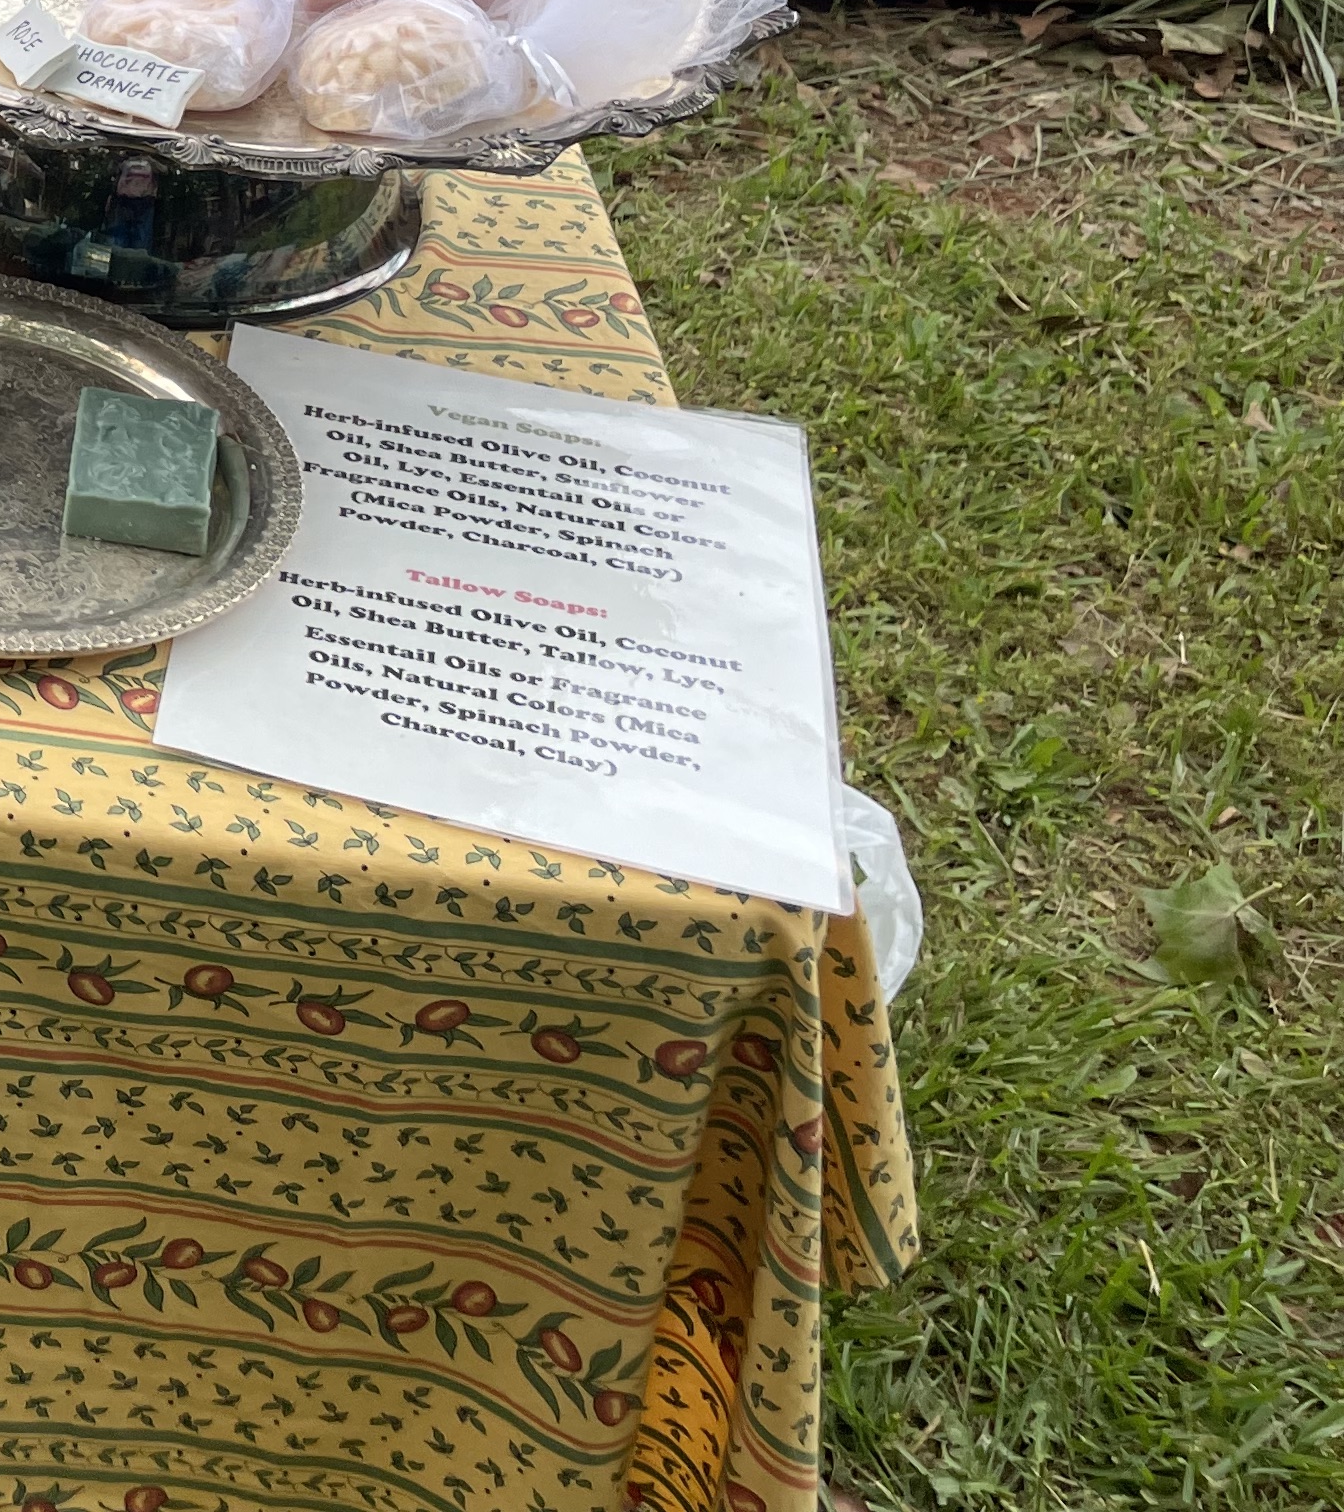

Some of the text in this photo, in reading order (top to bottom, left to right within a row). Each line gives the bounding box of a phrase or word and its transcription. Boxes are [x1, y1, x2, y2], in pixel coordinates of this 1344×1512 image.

[6, 20, 43, 52] ROSE
[74, 44, 189, 83] HOCOLATE
[77, 71, 162, 100] ORANGE
[304, 405, 731, 495] Herb-infused Olive Oil, Coconut
[428, 404, 601, 447] Vegan Soaps:
[303, 461, 727, 550] Fragrance Oils, Natural Colors
[326, 430, 705, 509] Oil, Shea Butter, Sunflower
[343, 452, 686, 523] Oil, Lye, Essentail Oils or
[339, 507, 683, 583] Powder, Charcoal, Clay)
[351, 490, 674, 560] (Mica Powder, Spinach
[279, 571, 743, 672] Herb-infused Olive Oil, Coconut
[406, 568, 608, 618] Tallow Soaps:
[291, 595, 724, 695] Oil, Shea Butter, Tallow, Lye,
[305, 625, 707, 720] Essentail Oils or Fragrance
[306, 671, 701, 771] Powder, Spinach Powder,
[308, 650, 700, 744] Oils, Natural Colors (Mica
[381, 712, 617, 776] Charcoal, Clay)
